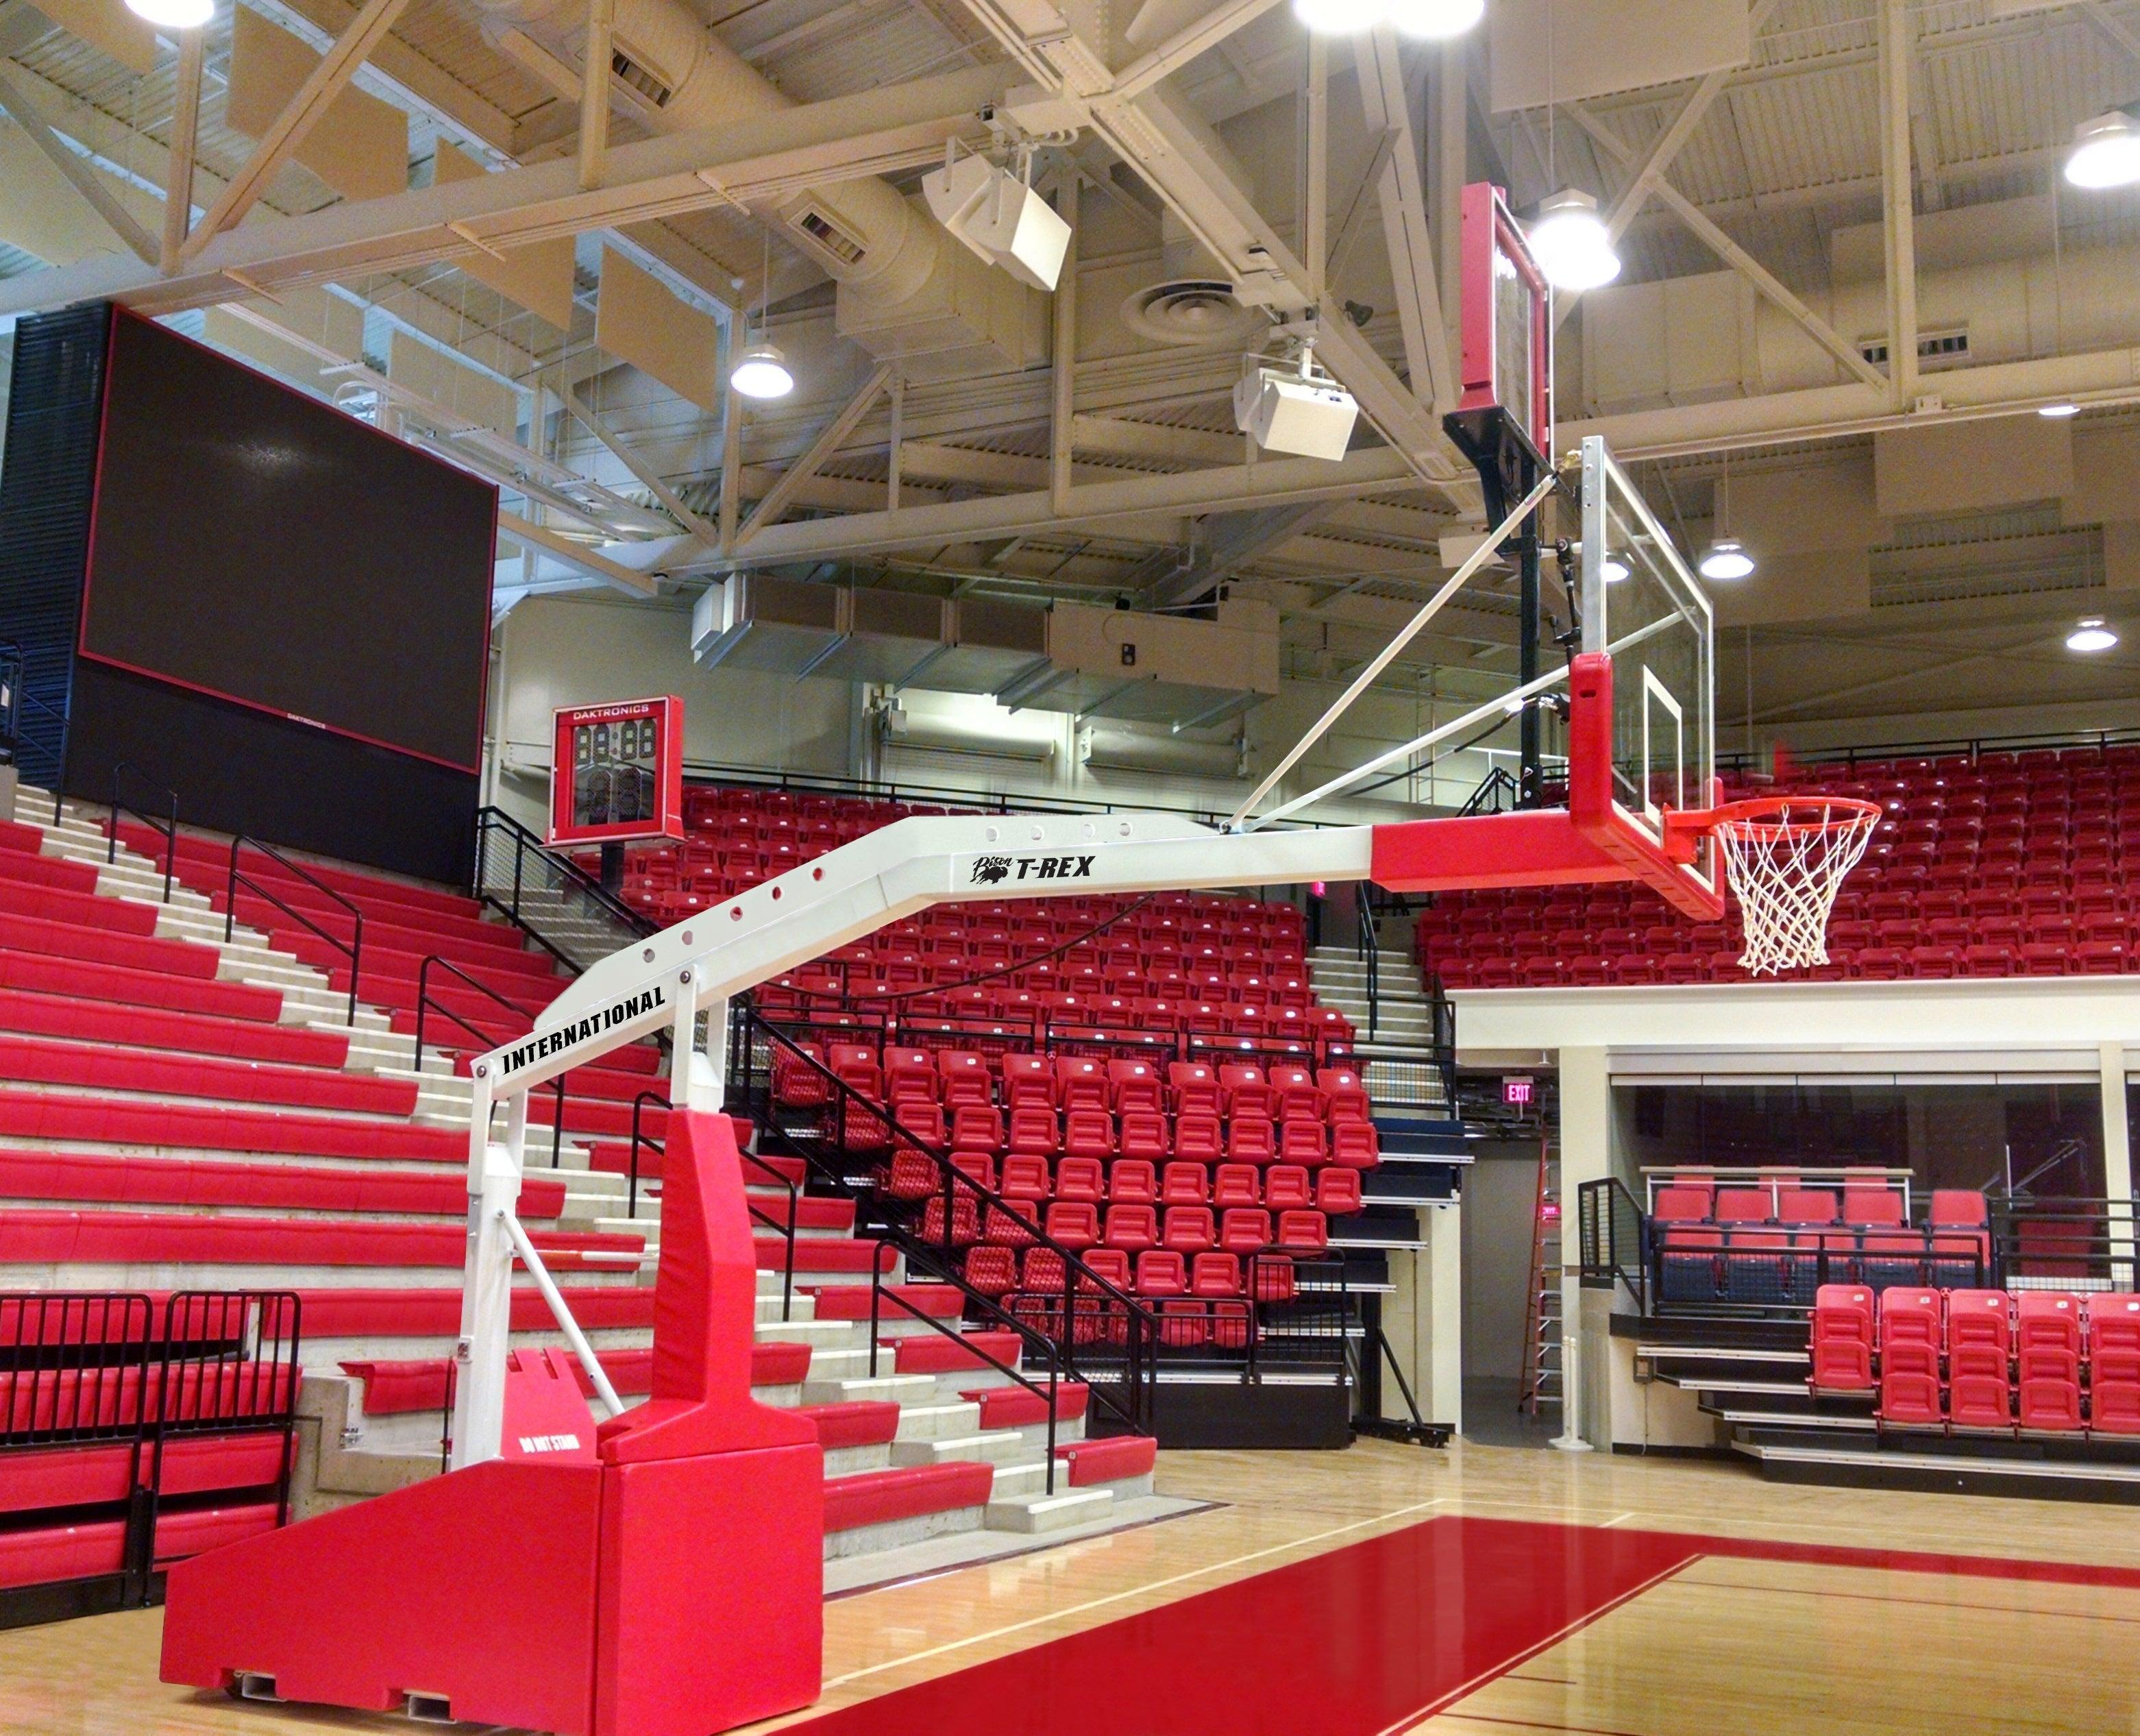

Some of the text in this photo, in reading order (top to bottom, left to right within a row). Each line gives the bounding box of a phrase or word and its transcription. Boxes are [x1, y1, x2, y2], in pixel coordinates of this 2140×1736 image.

[573, 704, 649, 720] DAKTRONICS
[972, 856, 1096, 879] Bison T-REX
[502, 986, 665, 1075] INTERNATIONAL
[1508, 1085, 1530, 1101] EXIT
